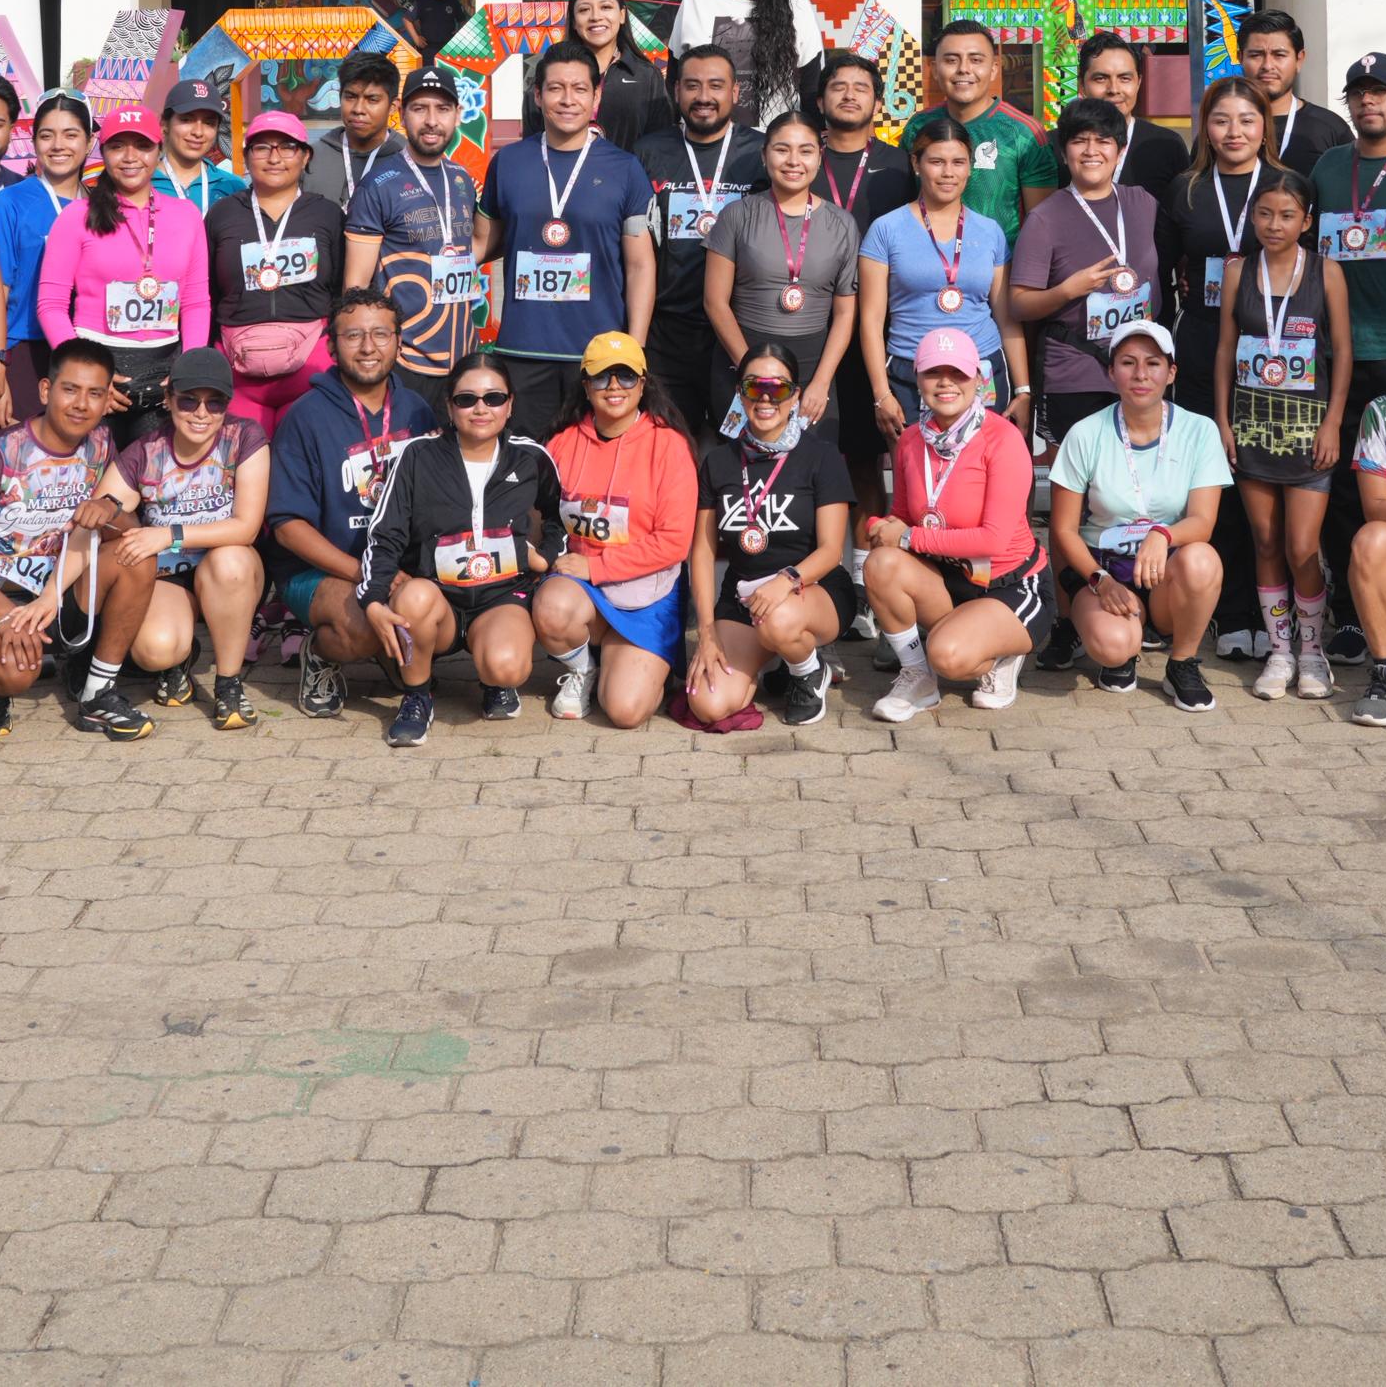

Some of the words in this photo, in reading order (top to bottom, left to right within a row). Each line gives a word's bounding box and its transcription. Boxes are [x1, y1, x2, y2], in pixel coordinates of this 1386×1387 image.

[119, 111, 143, 124] NY
[653, 180, 696, 194] VALLE
[404, 205, 457, 226] MEDO
[445, 271, 473, 296] 077
[533, 270, 571, 294] 187
[125, 298, 163, 322] 021
[1104, 302, 1144, 331] 045
[938, 334, 955, 352] LA
[1251, 354, 1306, 380] 09
[40, 481, 87, 499] MEDIO
[176, 484, 223, 503] MEDIO
[568, 513, 611, 542] 278
[455, 550, 502, 581] 21
